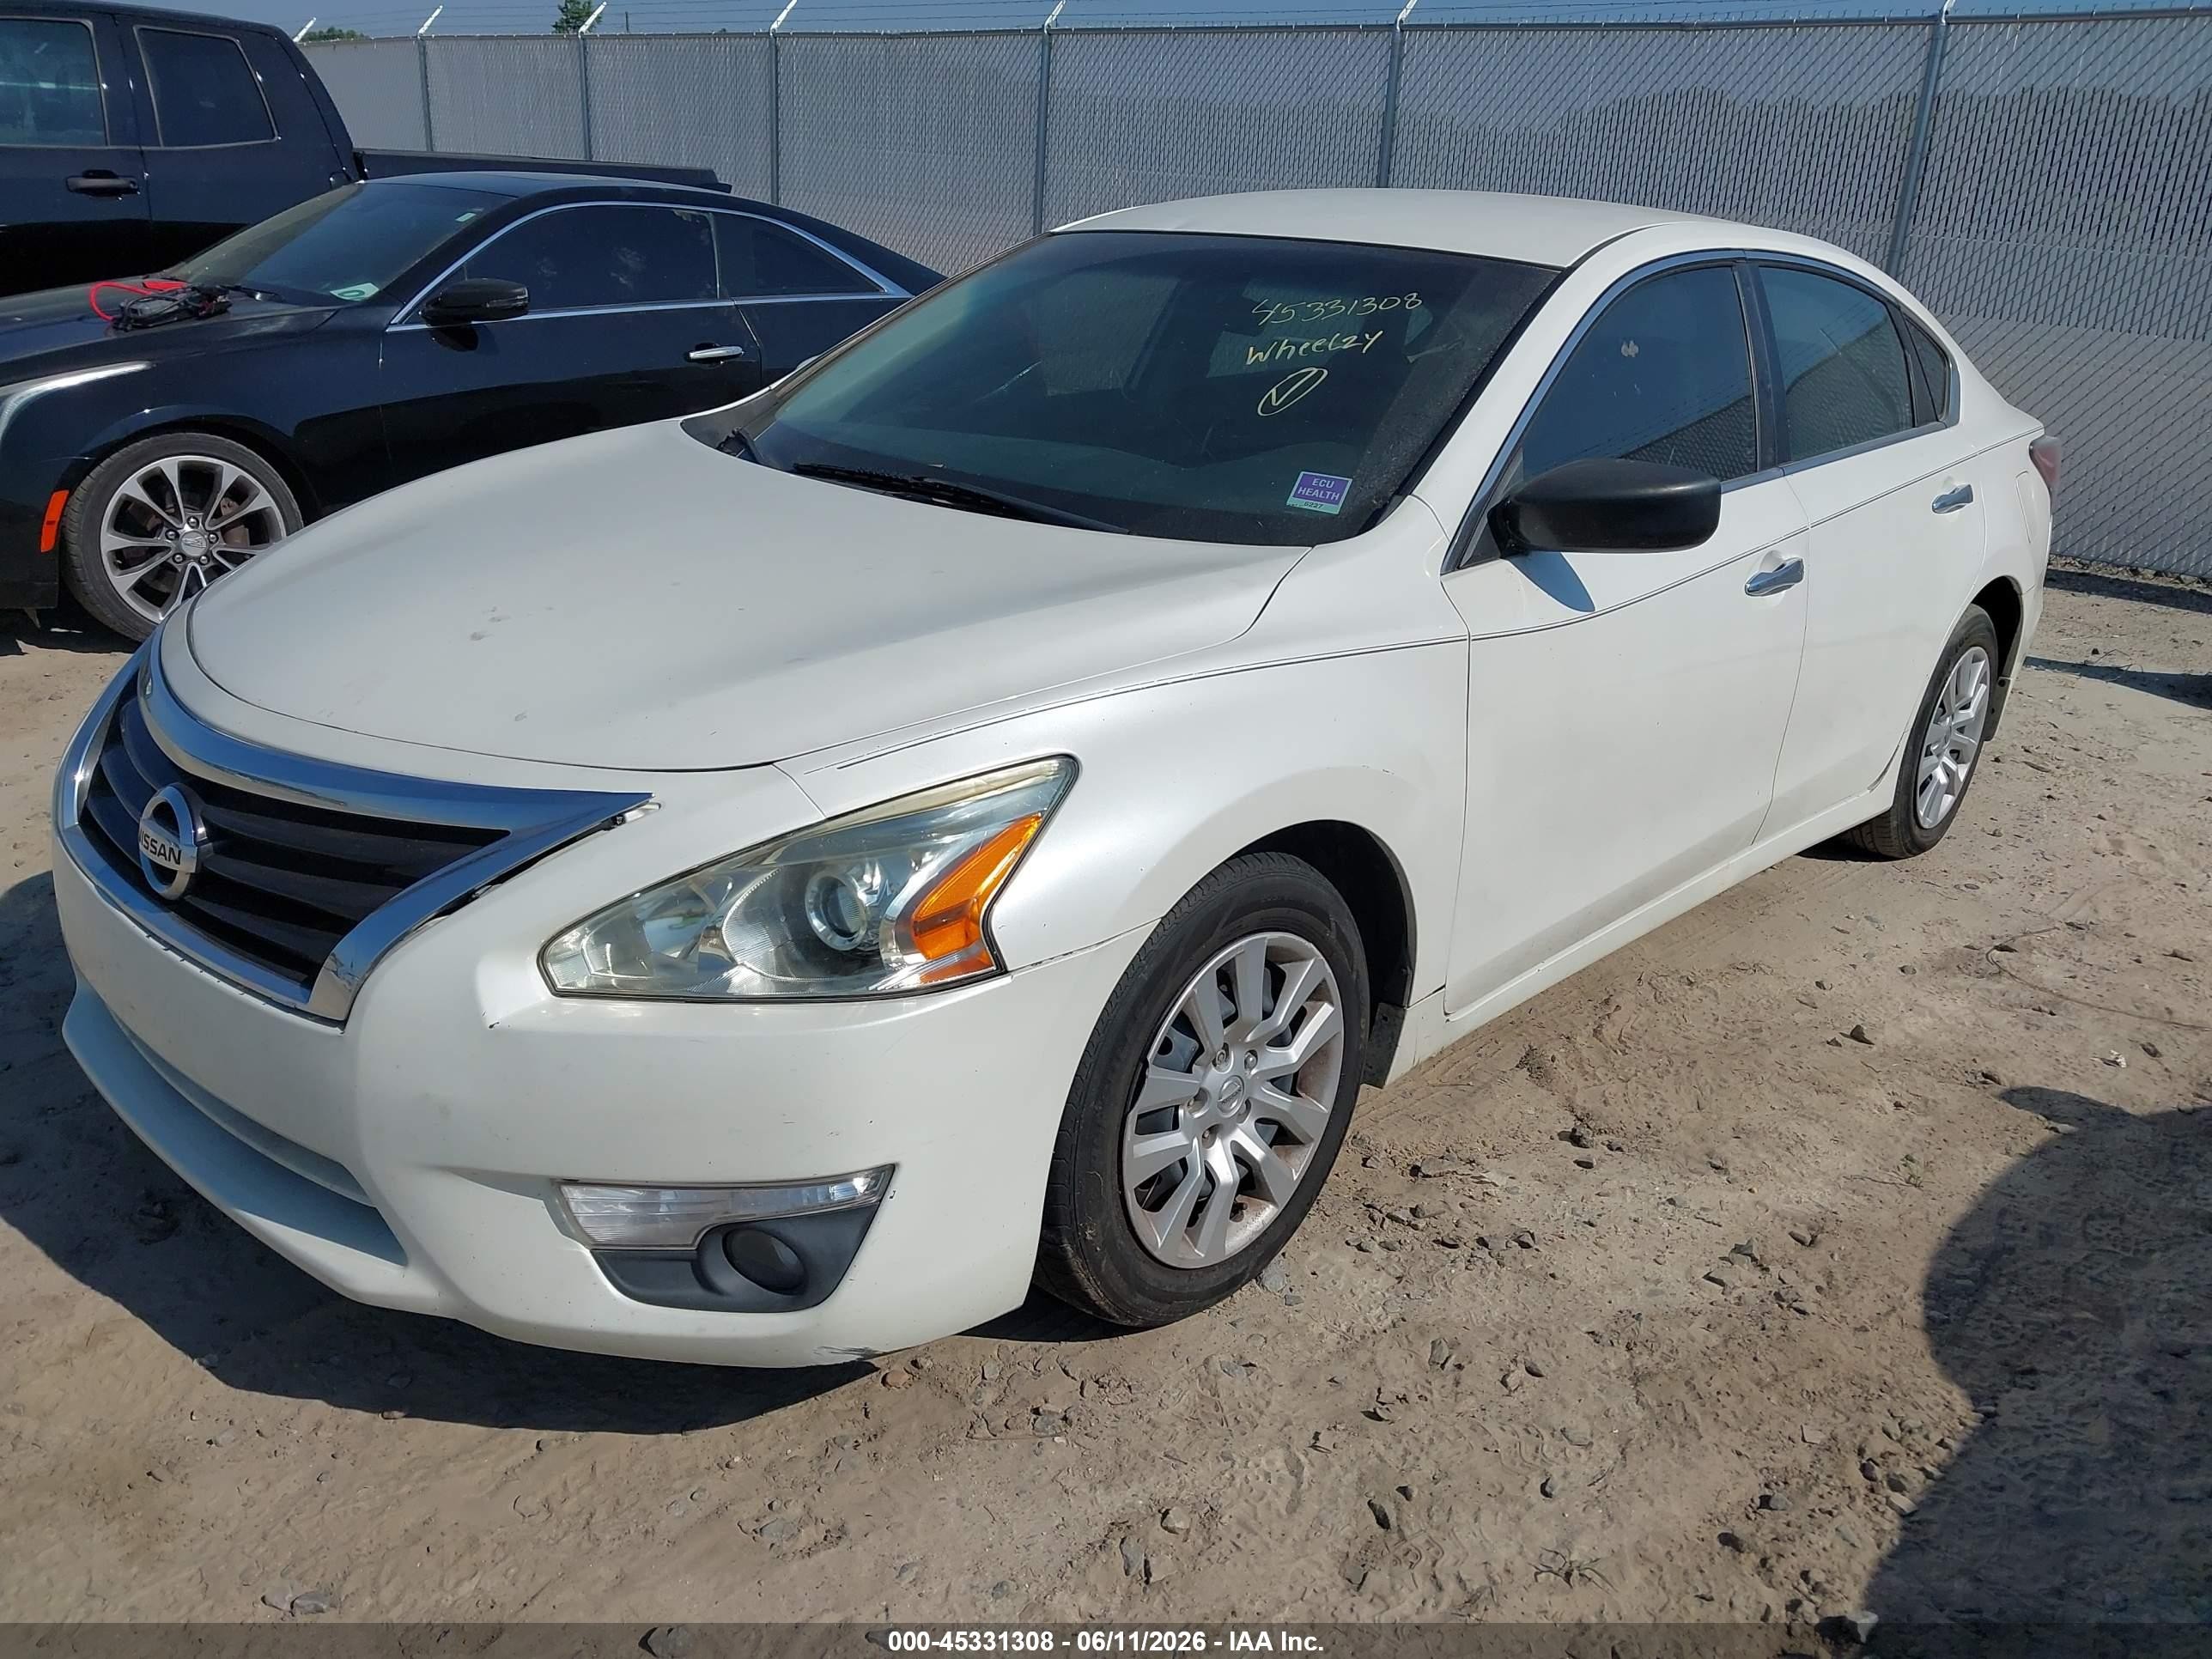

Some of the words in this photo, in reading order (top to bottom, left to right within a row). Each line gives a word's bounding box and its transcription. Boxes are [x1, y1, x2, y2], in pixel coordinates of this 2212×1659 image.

[1252, 293, 1422, 325] 45331308
[1312, 478, 1334, 488] ECU
[1297, 487, 1340, 501] HEALTH
